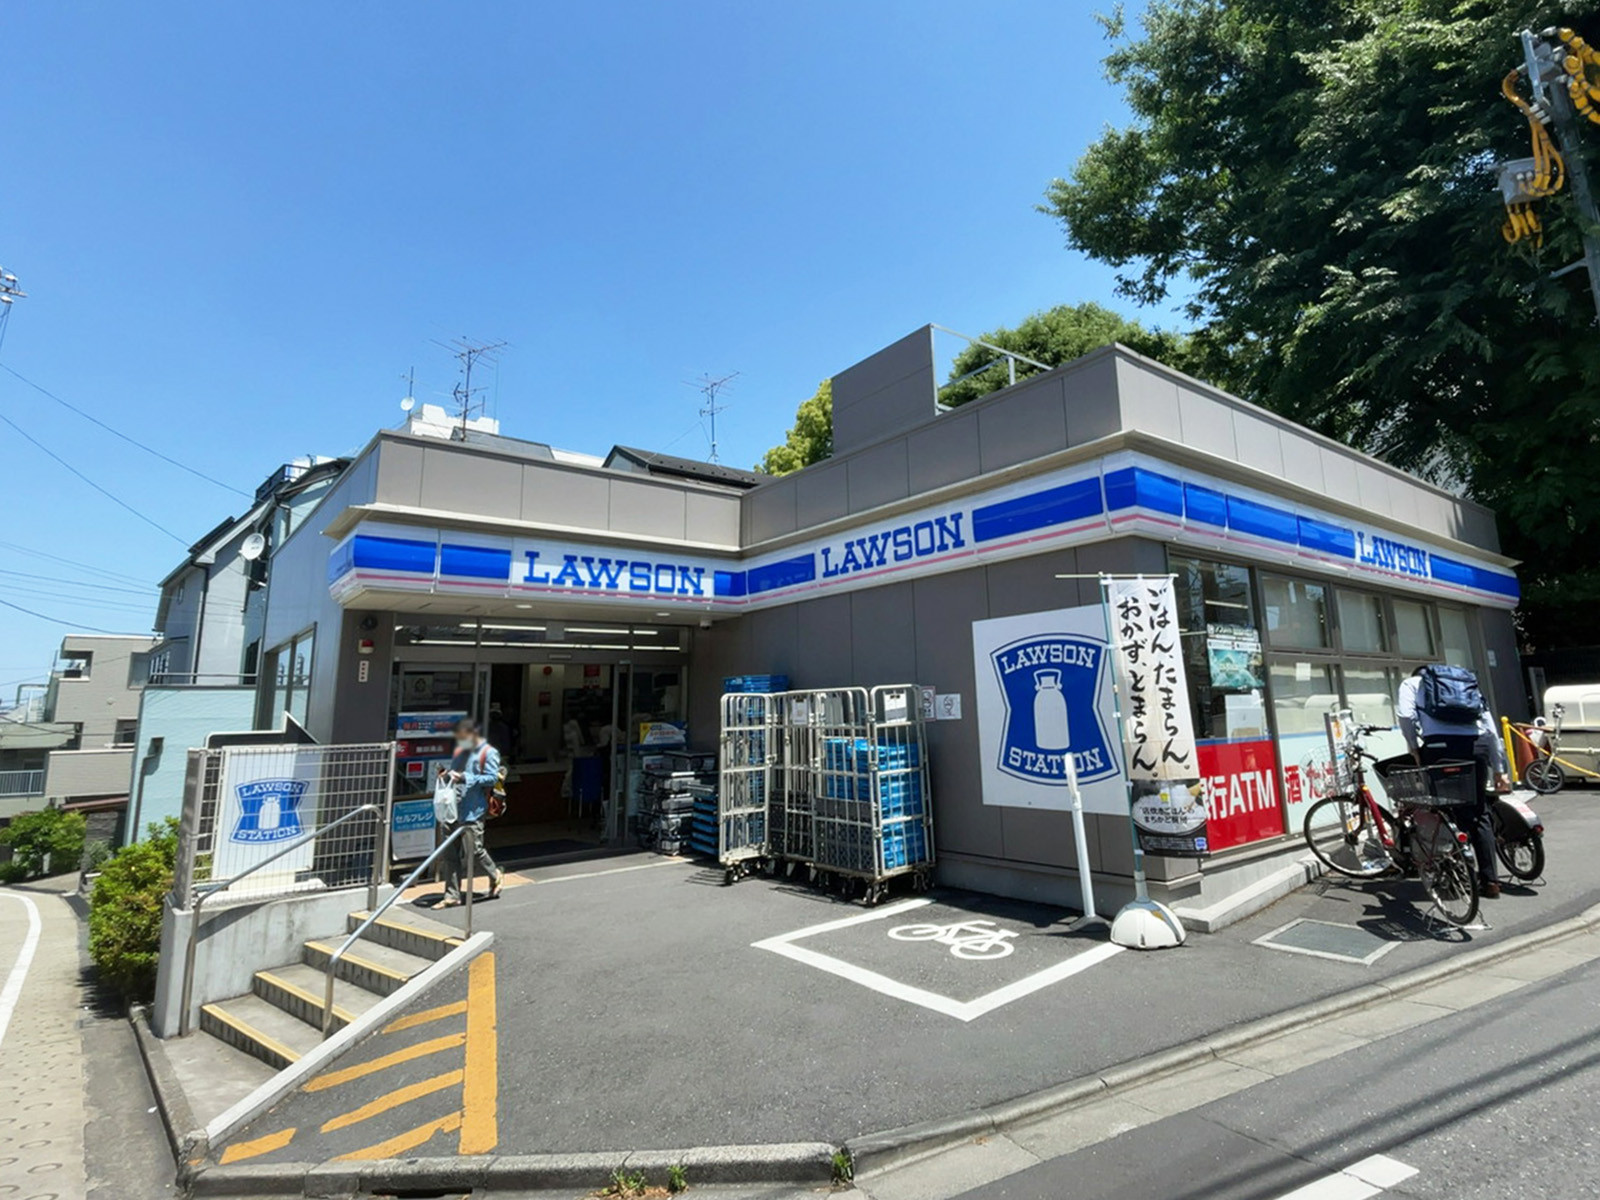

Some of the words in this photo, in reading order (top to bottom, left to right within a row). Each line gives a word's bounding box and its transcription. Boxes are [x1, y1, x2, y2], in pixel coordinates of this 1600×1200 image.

[820, 511, 966, 579] LAWSON
[1357, 531, 1429, 577] LAWSON
[523, 550, 706, 595] LAWSON
[1001, 643, 1096, 675] LAWSON
[1147, 588, 1190, 770] ごはん、たまらん。
[1116, 596, 1158, 778] おかず、とまらん。
[242, 782, 302, 797] LAWSON
[237, 825, 299, 840] STATION
